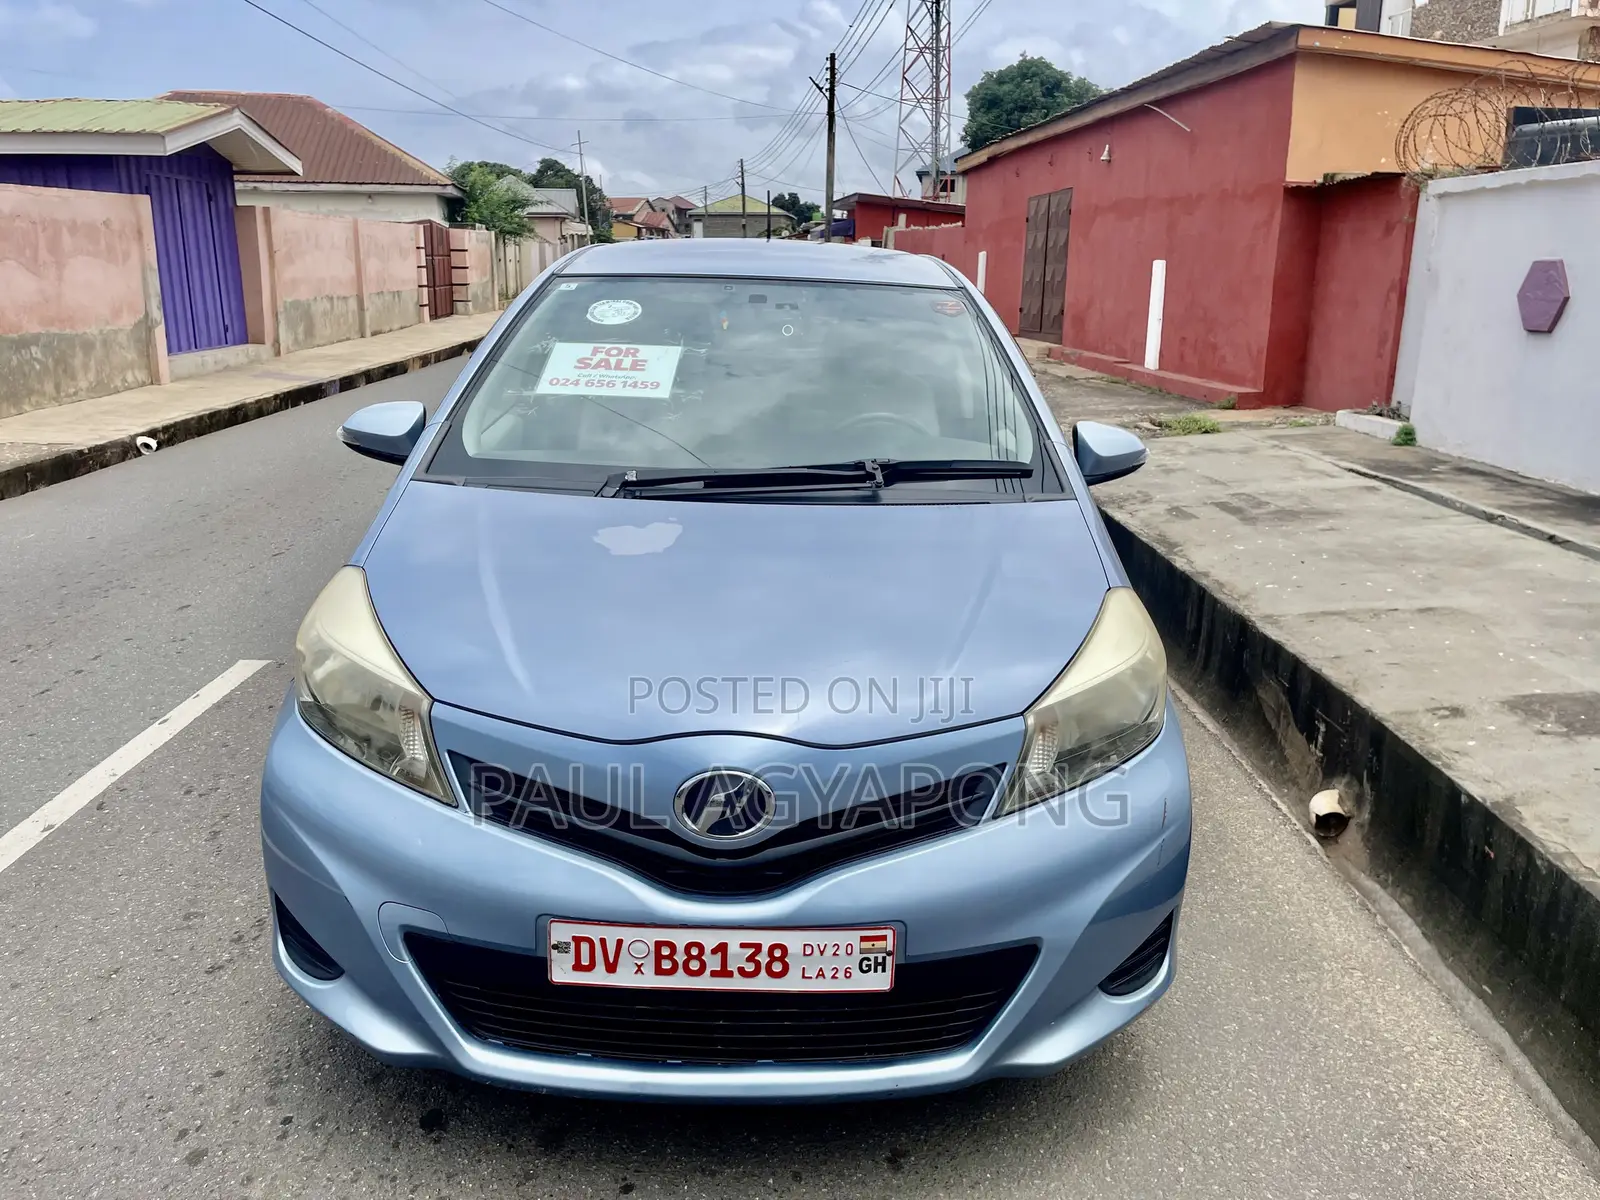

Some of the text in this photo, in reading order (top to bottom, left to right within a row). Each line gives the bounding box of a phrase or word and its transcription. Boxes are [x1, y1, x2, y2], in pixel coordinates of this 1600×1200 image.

[590, 346, 640, 358] FOR
[574, 356, 648, 371] SALE
[549, 377, 661, 389] 024 656 1459
[571, 934, 790, 979] DV B8138
[802, 943, 854, 957] DV20
[858, 956, 887, 975] GH
[802, 966, 853, 980] LA26
